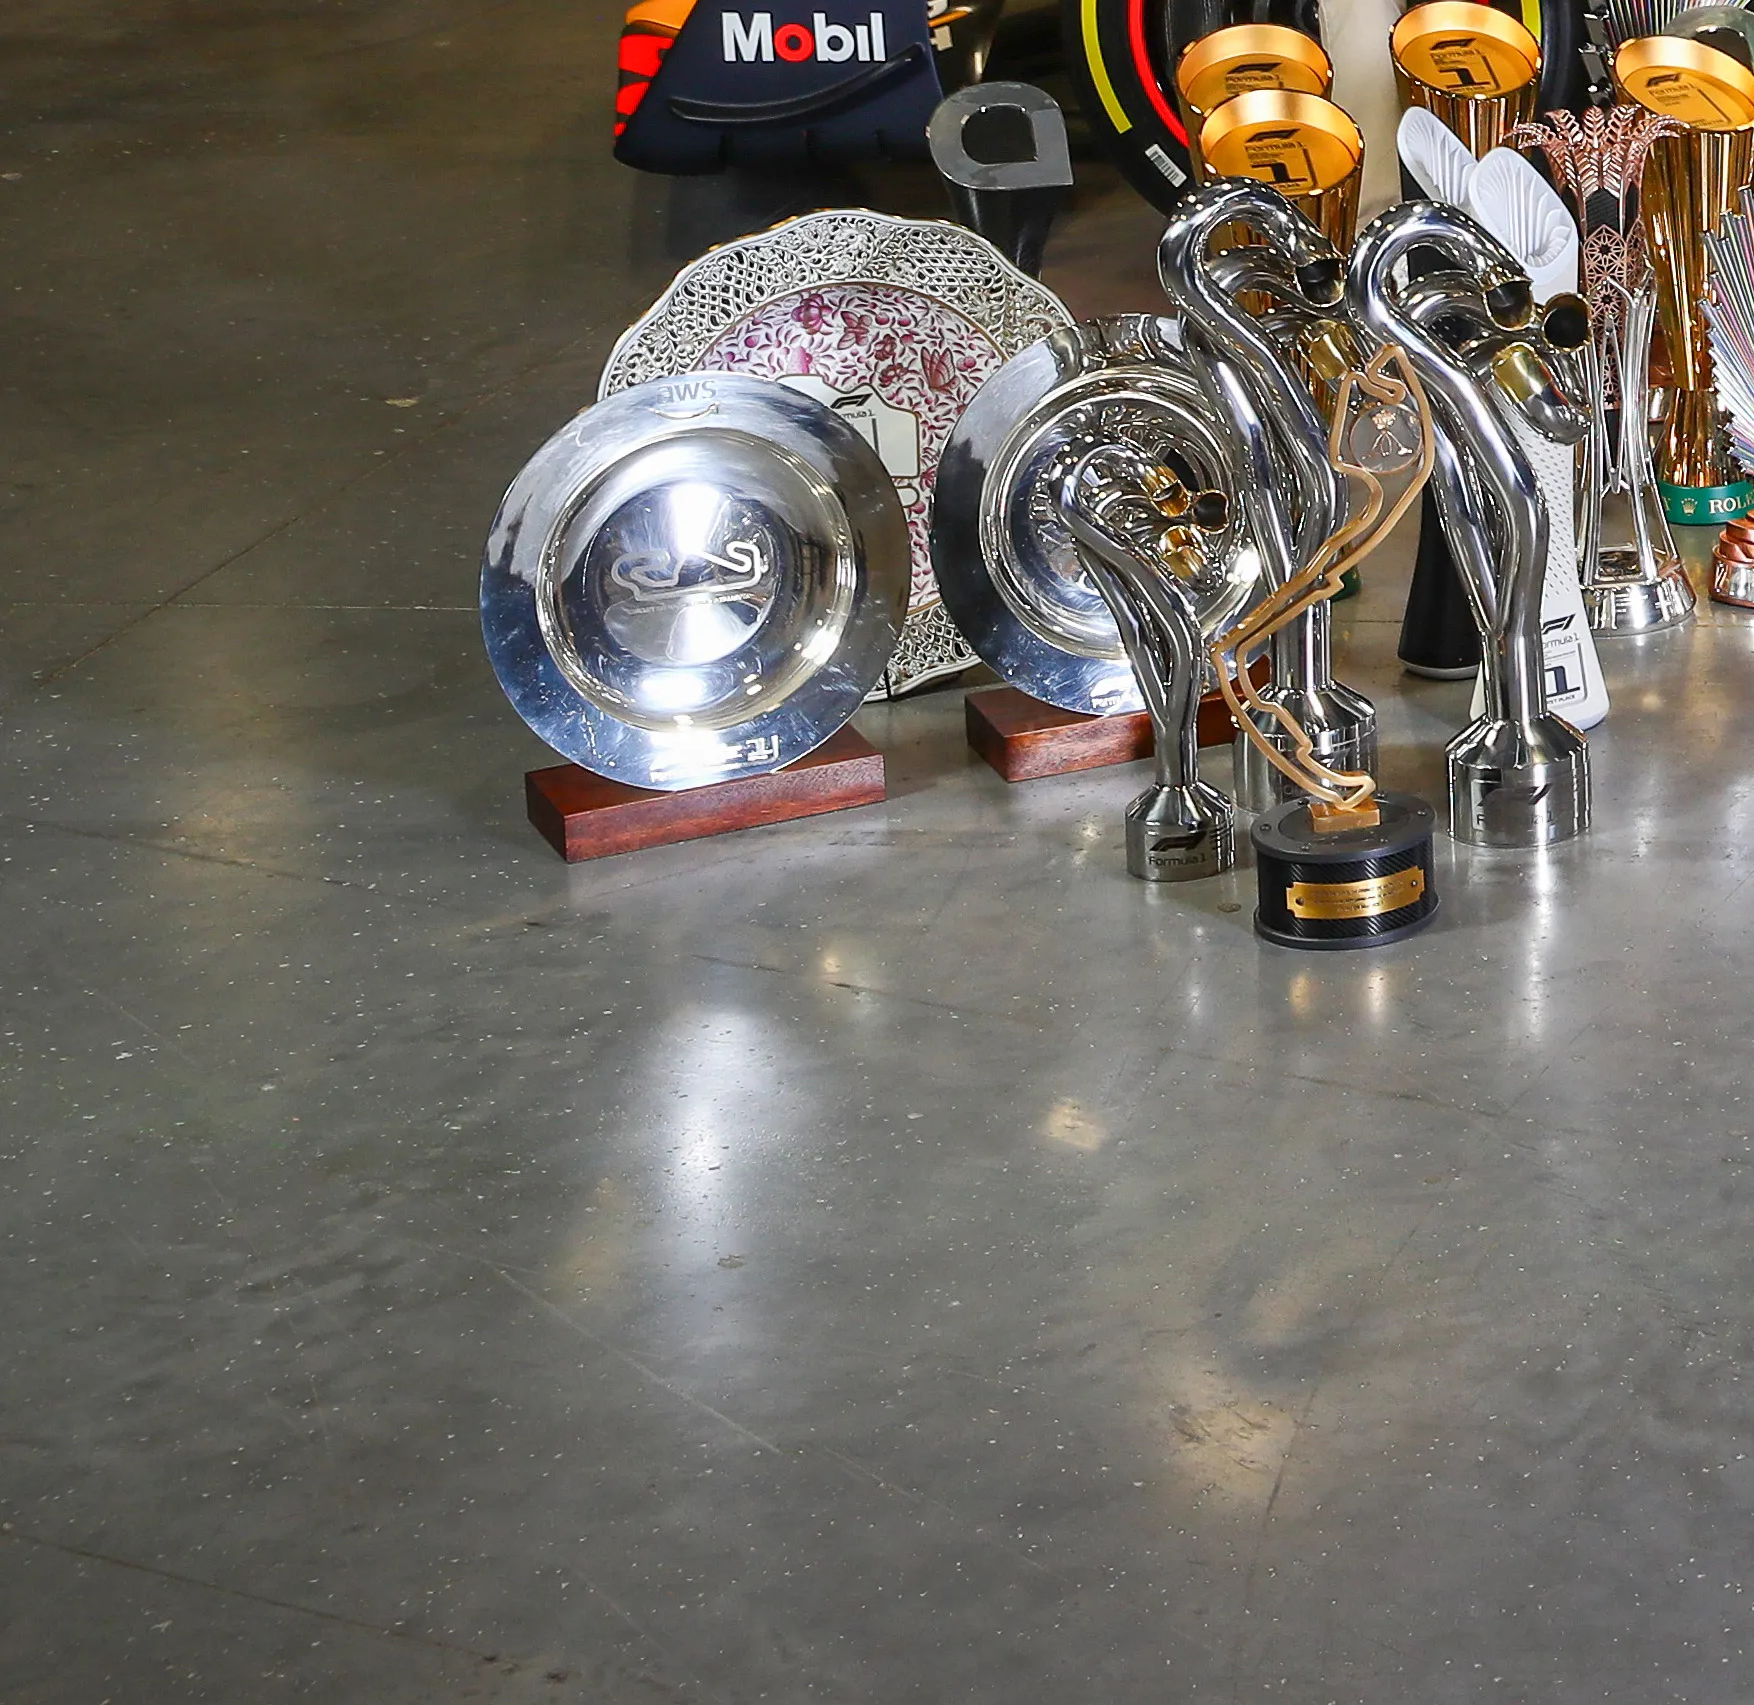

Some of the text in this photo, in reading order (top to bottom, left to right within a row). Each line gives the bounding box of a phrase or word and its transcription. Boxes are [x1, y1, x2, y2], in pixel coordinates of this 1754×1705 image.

[720, 11, 887, 64] Mobil
[656, 379, 718, 405] aws
[1542, 635, 1574, 649] ormula
[1148, 853, 1198, 867] Formula
